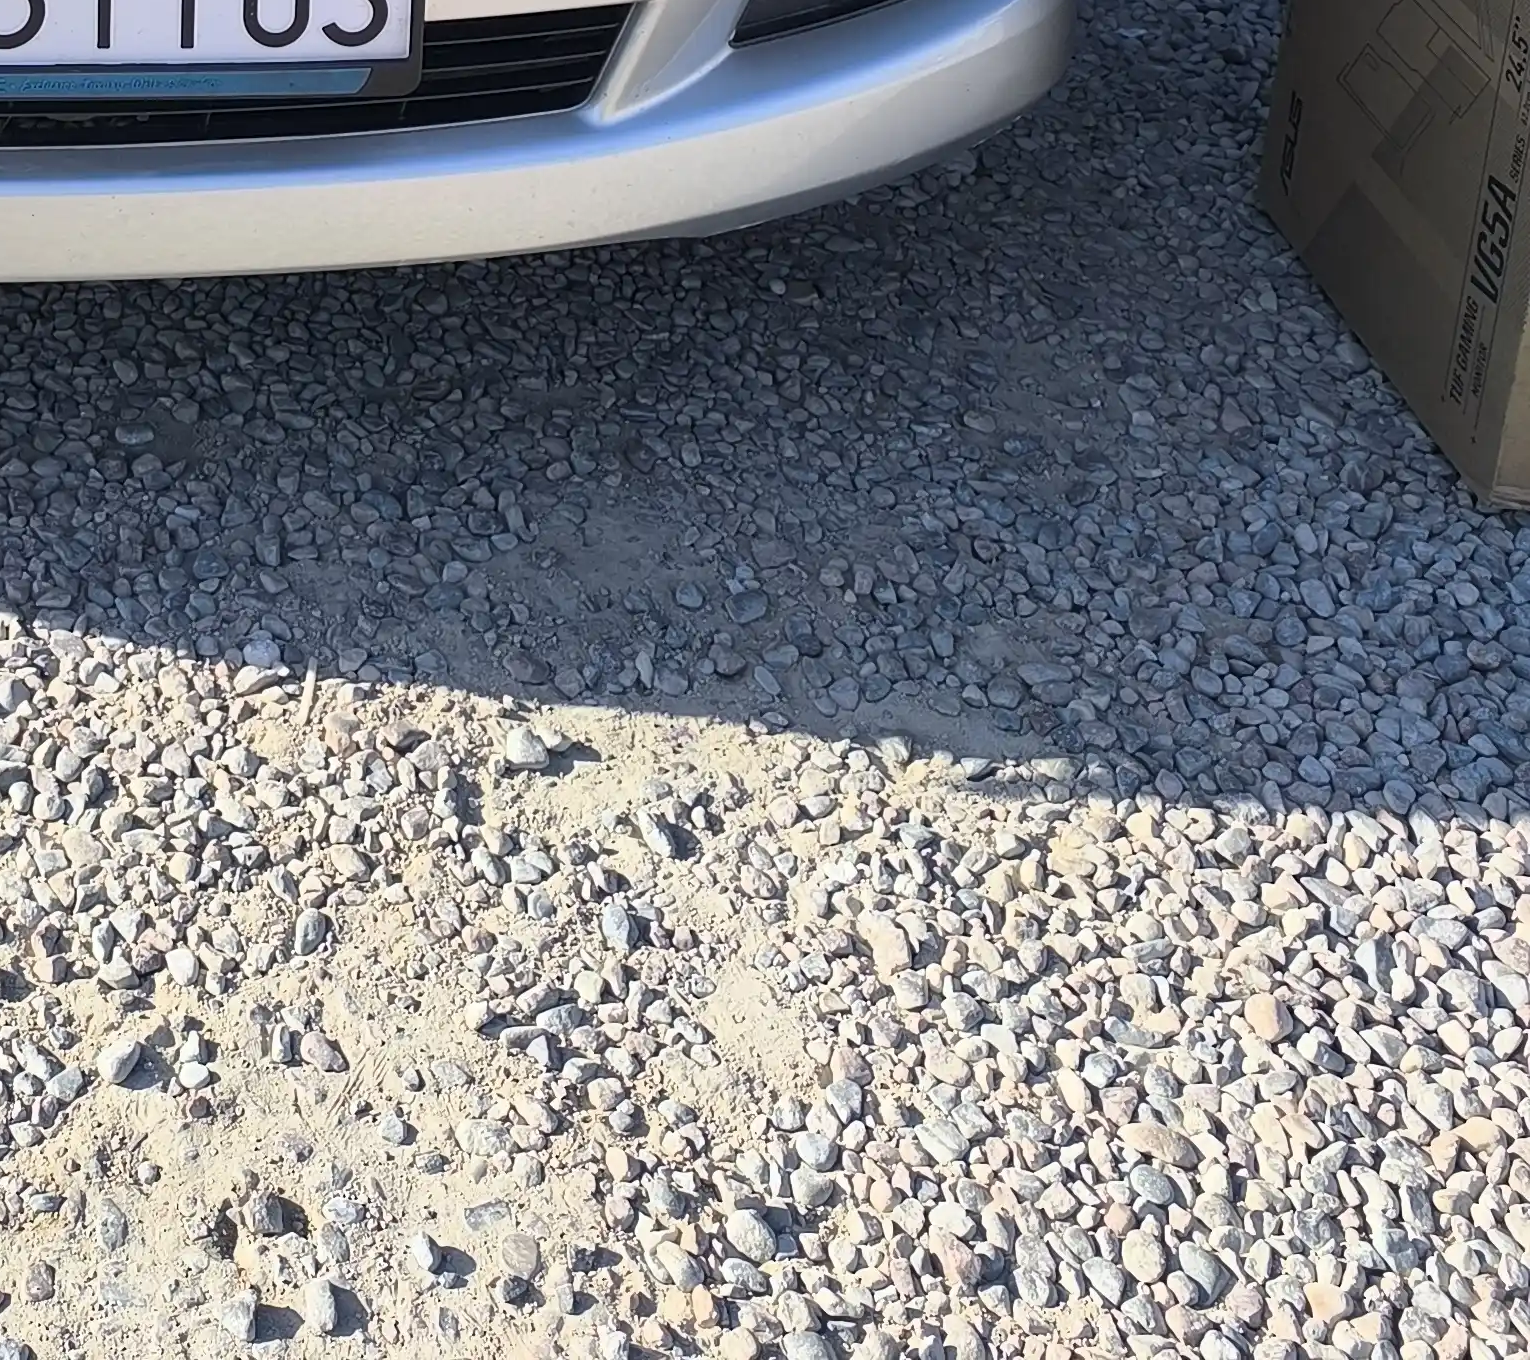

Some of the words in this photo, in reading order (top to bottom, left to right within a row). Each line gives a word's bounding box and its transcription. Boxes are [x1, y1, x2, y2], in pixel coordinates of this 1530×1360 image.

[1280, 89, 1302, 196] ASUS
[1471, 175, 1517, 304] VG5A
[1508, 134, 1526, 182] SERIES
[1454, 295, 1480, 372] GAMING
[1471, 342, 1488, 399] MONITOR
[1449, 369, 1465, 405] TUF
